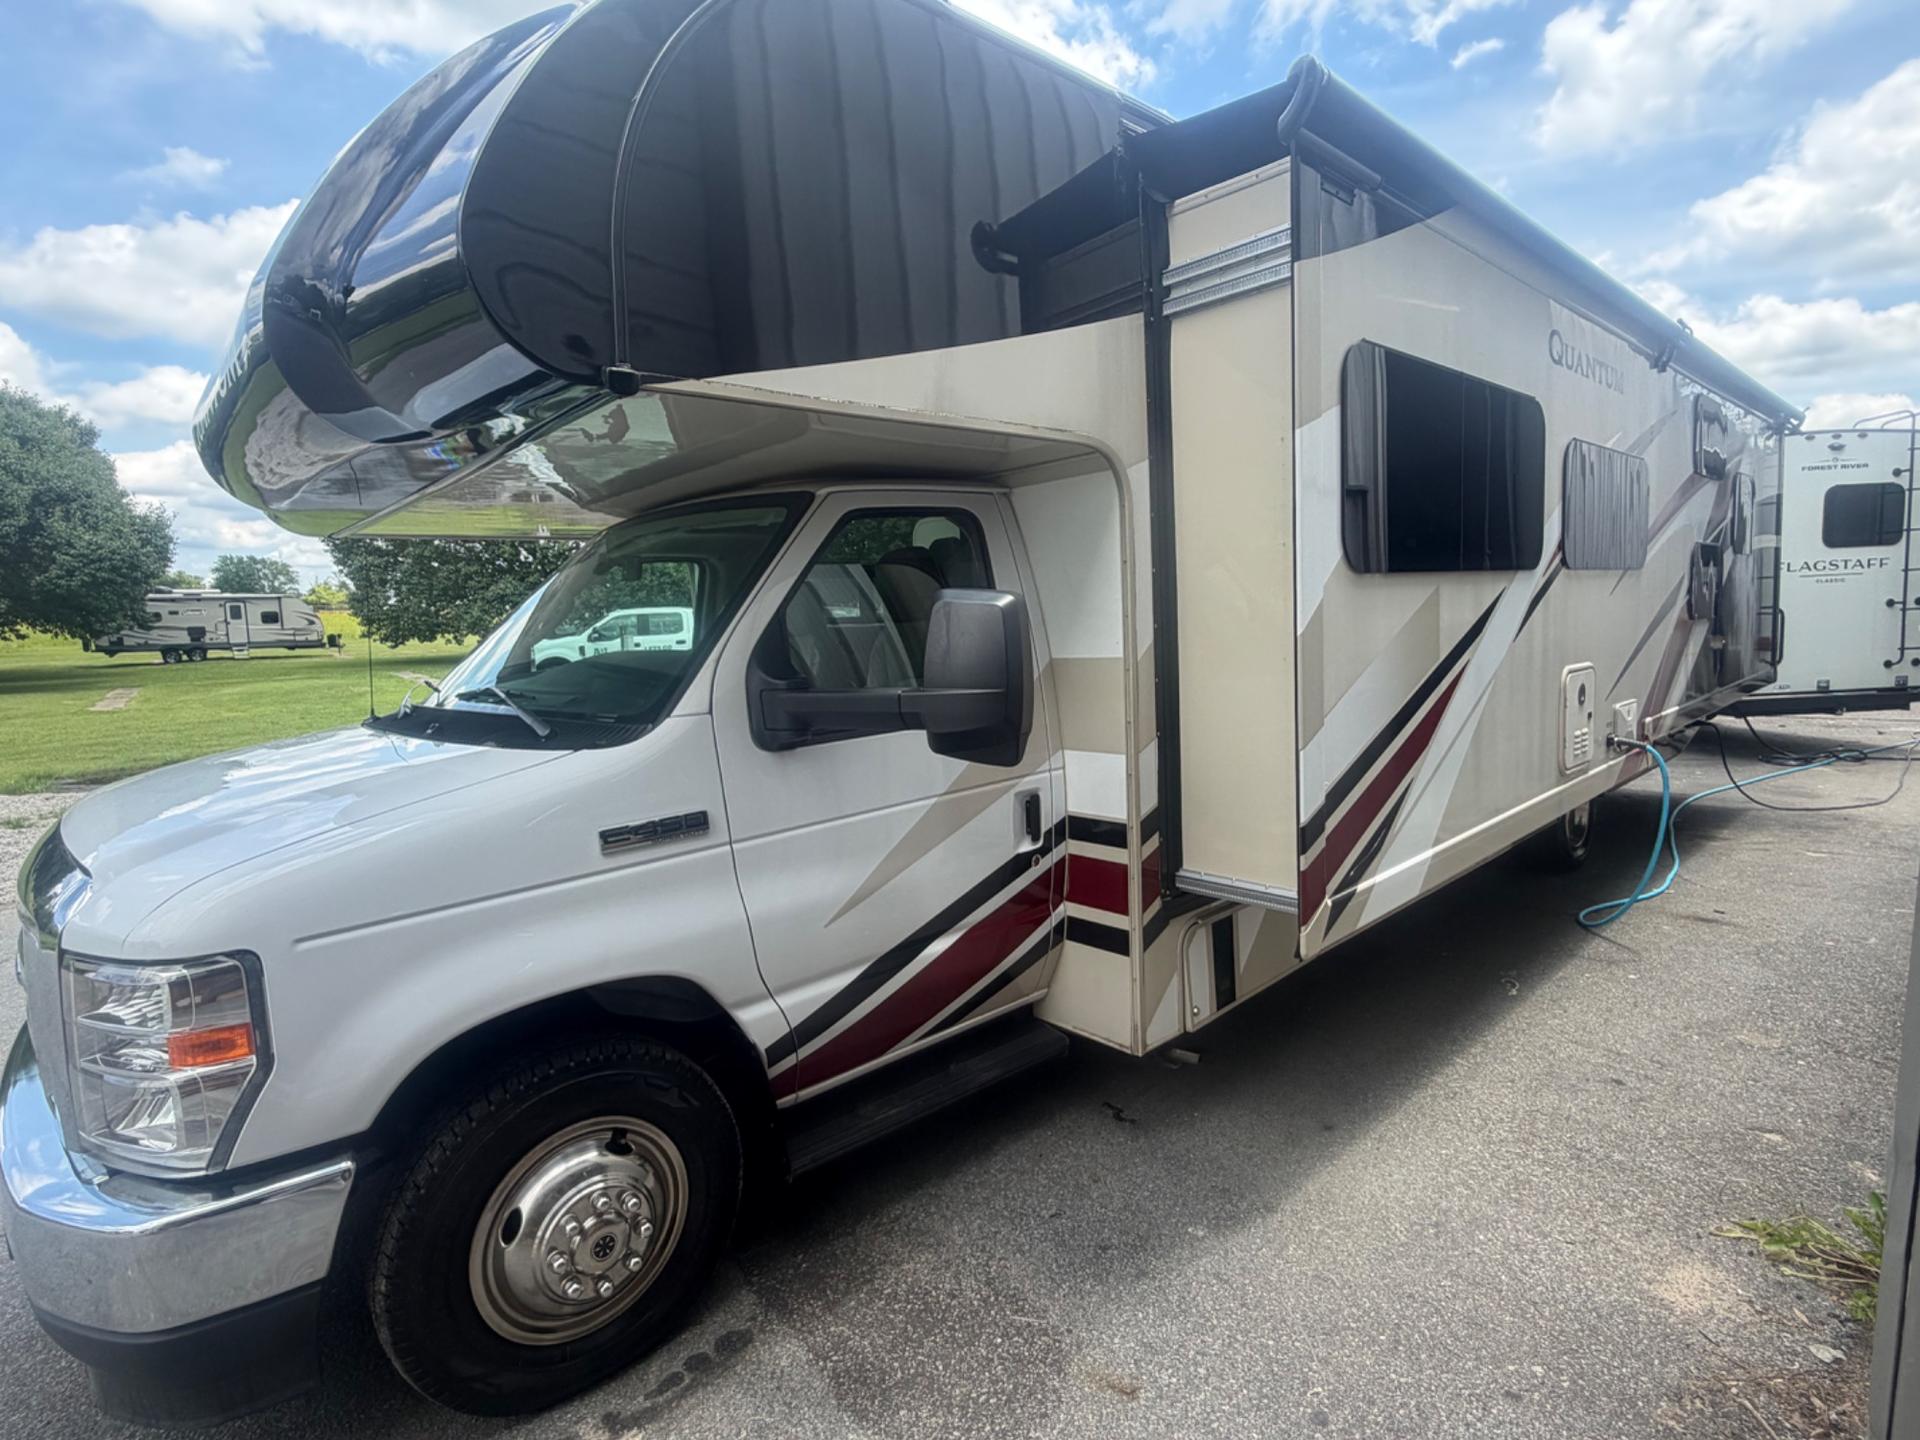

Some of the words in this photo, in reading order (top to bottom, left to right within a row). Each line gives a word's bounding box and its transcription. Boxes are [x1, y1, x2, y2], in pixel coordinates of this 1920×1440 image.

[1548, 328, 1624, 395] QUANTUM
[1801, 464, 1839, 472] FOREST
[1840, 462, 1869, 470] RIVER
